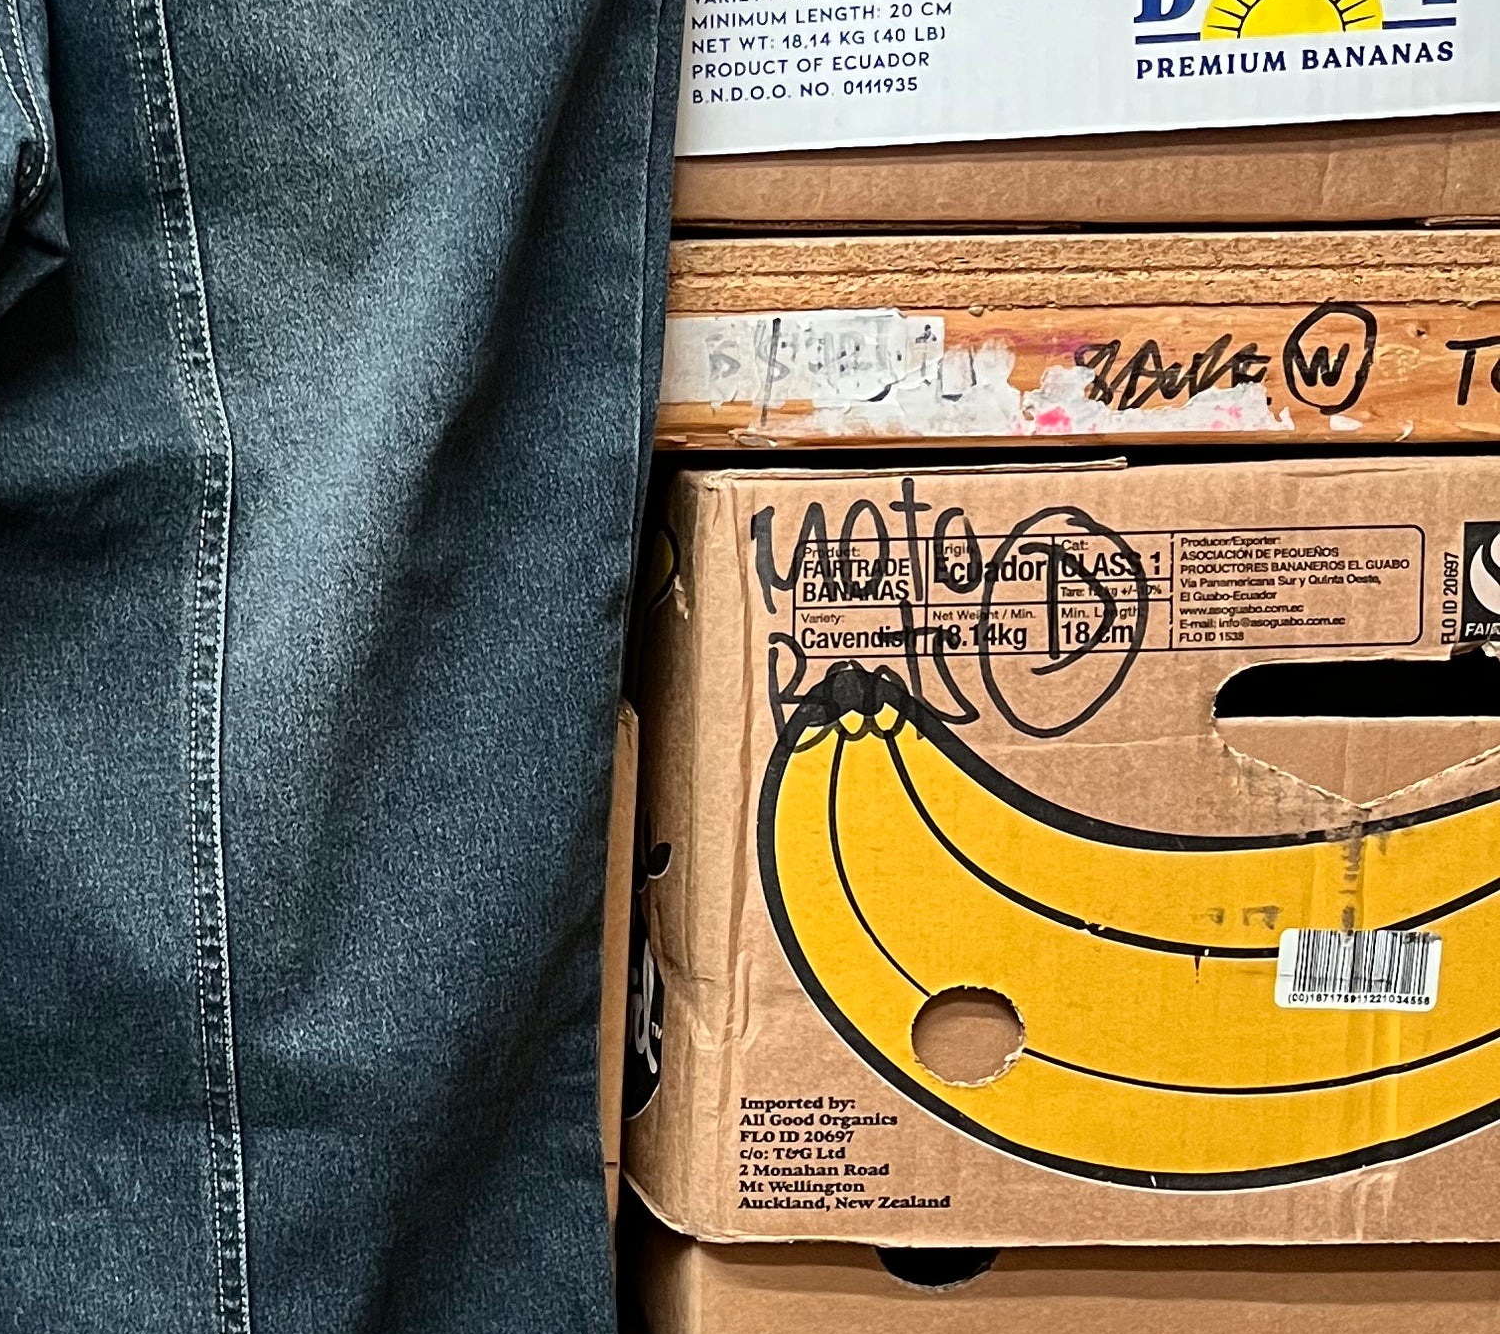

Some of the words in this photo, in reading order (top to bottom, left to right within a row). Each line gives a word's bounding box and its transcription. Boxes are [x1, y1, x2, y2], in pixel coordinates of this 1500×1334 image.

[692, 8, 787, 30] MINIMUM
[795, 5, 881, 24] LENGTH:
[889, 3, 913, 20] 20
[921, 2, 953, 17] CM
[692, 37, 731, 55] NET
[781, 31, 832, 50] 18.14
[839, 30, 865, 46] KG
[692, 60, 788, 79] PRODUCT
[796, 58, 824, 74] OF
[832, 51, 931, 71] ECUADOR
[1136, 50, 1286, 80] PREMIUM
[1302, 40, 1455, 71] BANANAS
[1180, 562, 1269, 575] PRODUCTORES
[1271, 560, 1346, 573] BANANEROS
[1365, 559, 1410, 570] GUABO
[1443, 551, 1460, 597] 20697
[740, 1096, 824, 1112] Imported
[828, 1096, 856, 1113] by:
[740, 1113, 766, 1126] All
[769, 1113, 814, 1127] Good
[819, 1112, 898, 1129] Organics
[803, 1130, 855, 1145] 20697
[752, 1164, 839, 1178] Monahan
[844, 1164, 889, 1177] Road
[768, 1180, 866, 1196] Wellington
[738, 1196, 832, 1213] Auckland,
[834, 1196, 876, 1210] New
[878, 1195, 952, 1210] Zealand
